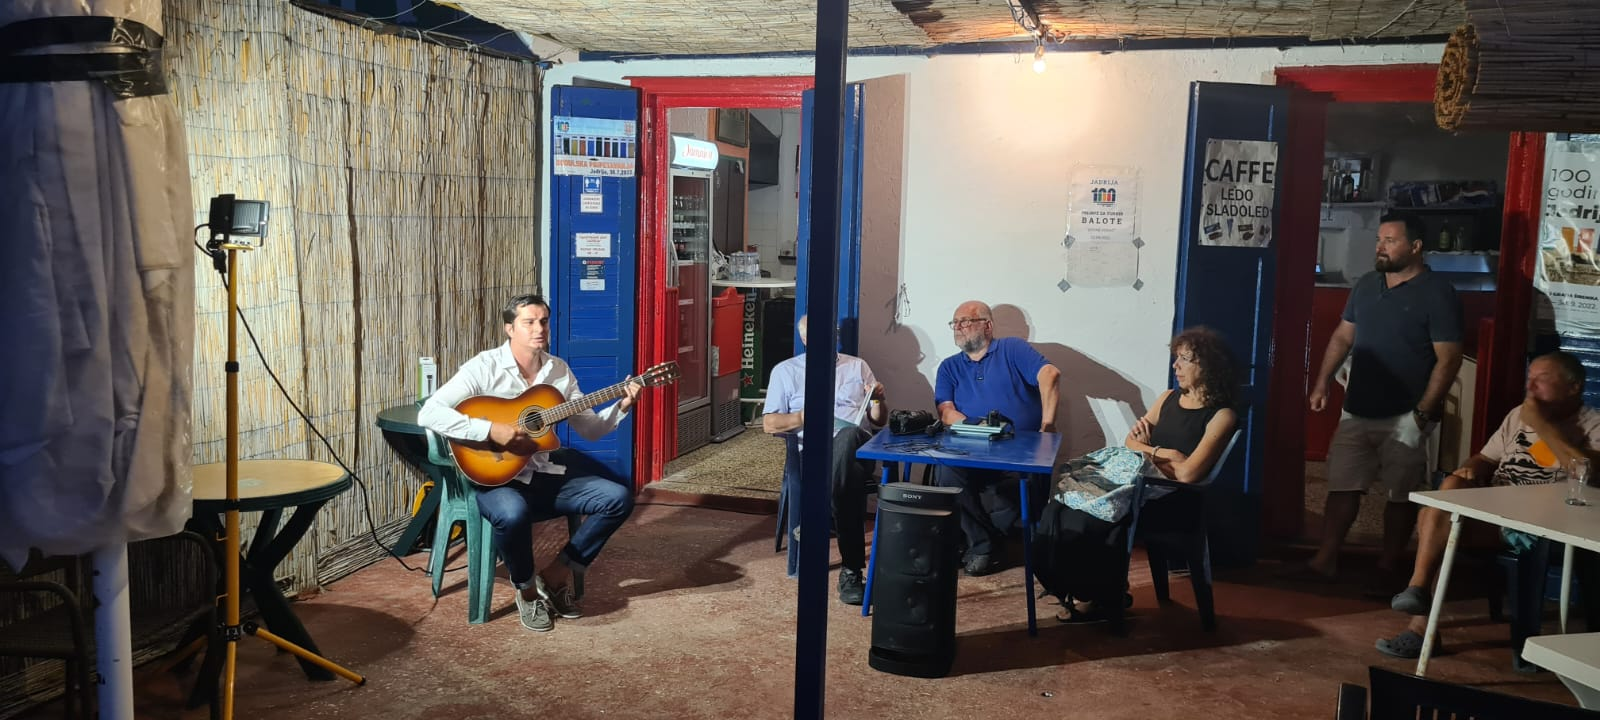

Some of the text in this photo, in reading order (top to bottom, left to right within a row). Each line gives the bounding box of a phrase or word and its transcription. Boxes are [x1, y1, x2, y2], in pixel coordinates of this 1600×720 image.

[1205, 158, 1275, 184] CAFFE
[1551, 168, 1592, 183] 100
[1091, 187, 1116, 203] 100
[1221, 187, 1254, 202] LEDO
[1206, 203, 1270, 218] SLADOLED
[1081, 216, 1123, 224] BALOTE
[741, 289, 757, 369] Heineken
